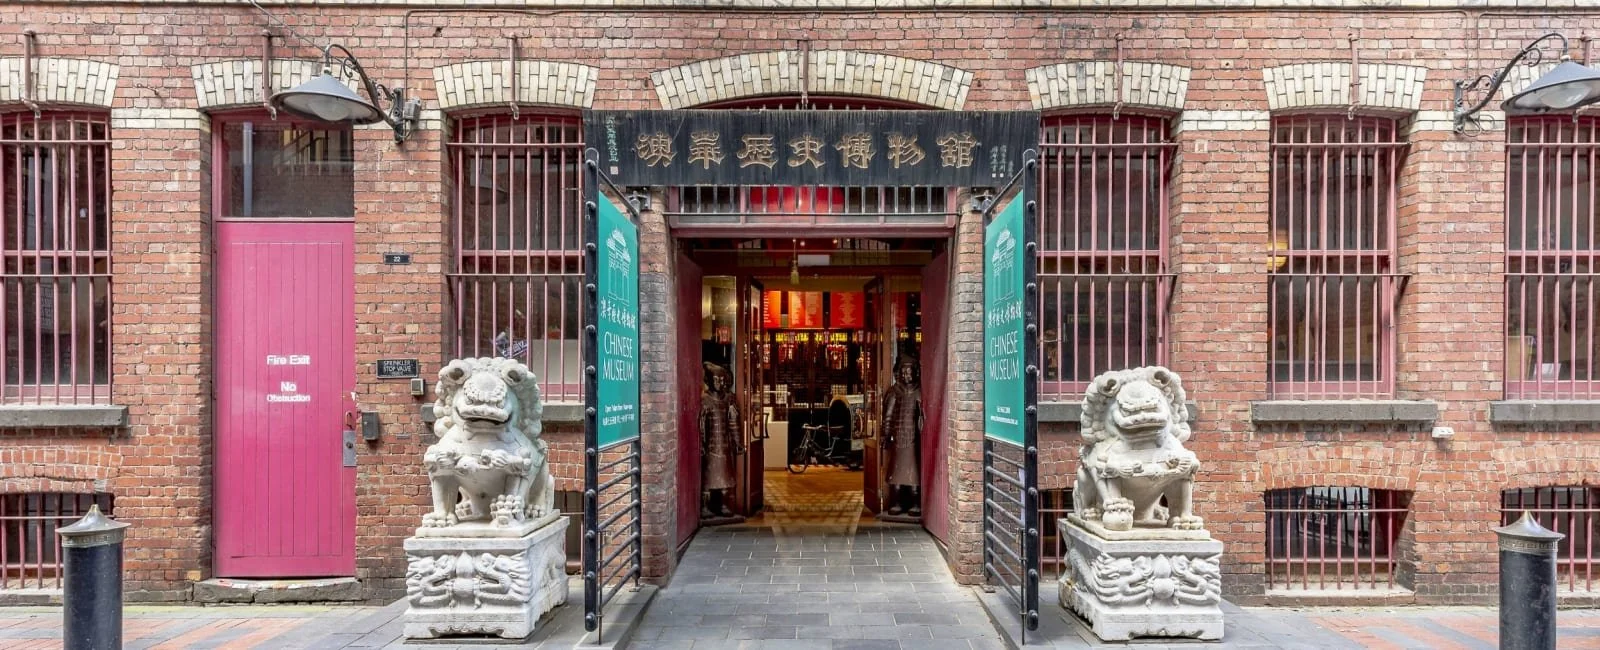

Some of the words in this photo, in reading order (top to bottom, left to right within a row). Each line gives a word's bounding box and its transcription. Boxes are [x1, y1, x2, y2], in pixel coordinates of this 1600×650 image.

[604, 331, 633, 359] CHINESE
[990, 330, 1018, 358] CHINESE
[266, 354, 287, 365] Fire
[289, 354, 310, 365] Exit
[603, 357, 634, 382] MUSEUM
[989, 356, 1019, 381] MUSEUM
[266, 394, 311, 402] Obstruction
[280, 381, 297, 392] No
